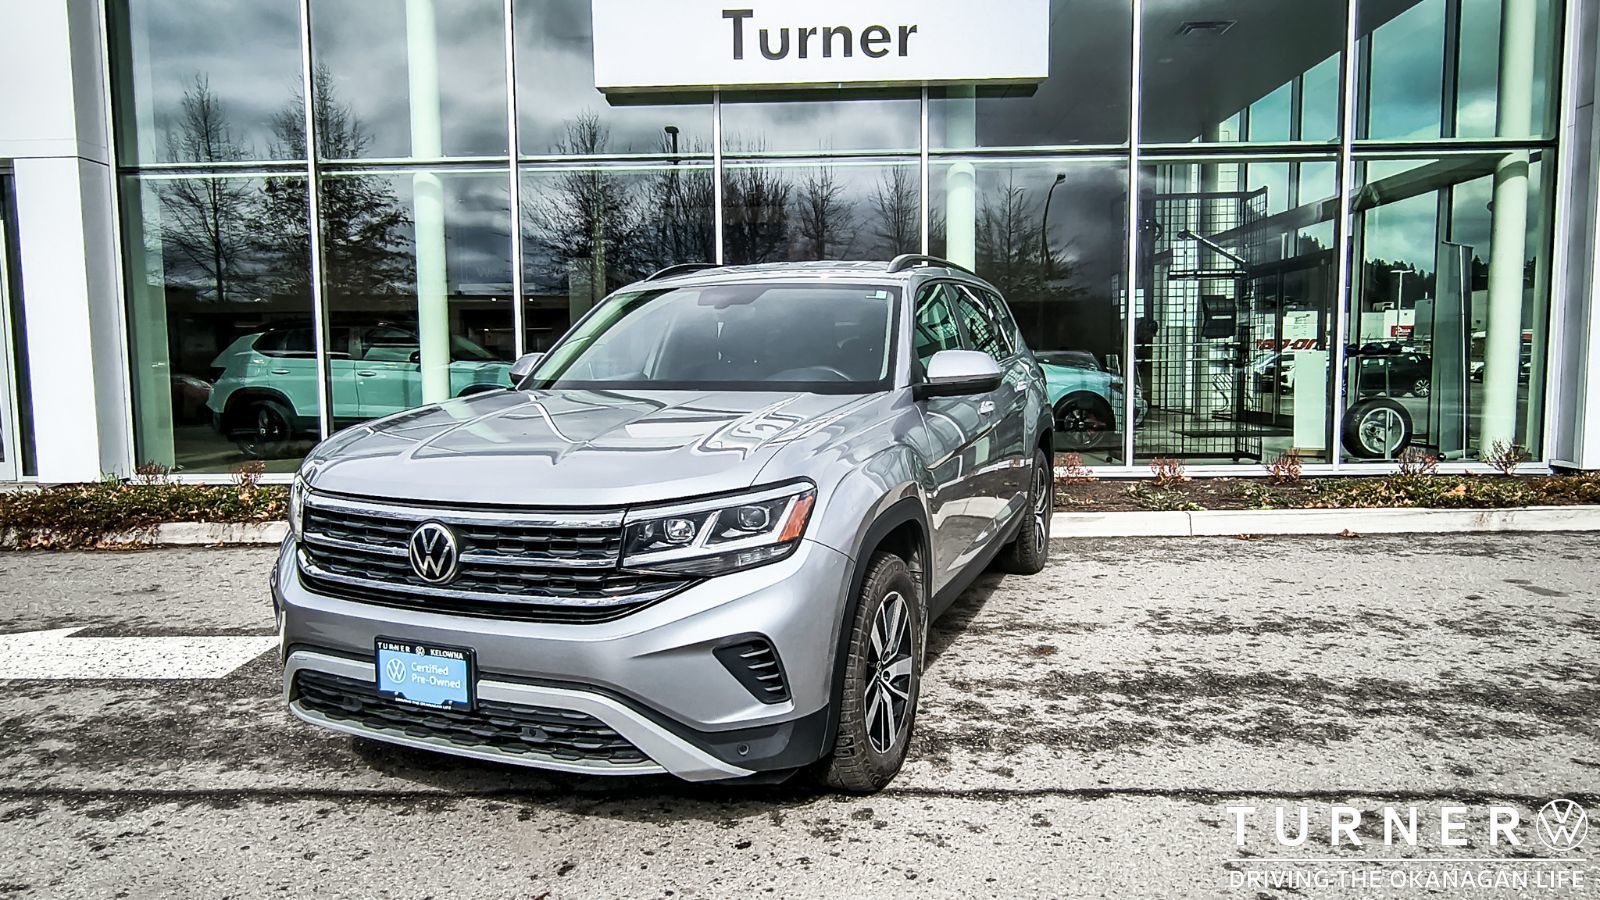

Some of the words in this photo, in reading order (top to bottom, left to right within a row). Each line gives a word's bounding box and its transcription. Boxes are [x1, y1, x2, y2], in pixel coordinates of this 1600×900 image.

[722, 9, 917, 60] Turner
[377, 642, 411, 653] TURNER
[430, 648, 464, 660] KELOWNA
[411, 662, 449, 676] Certified
[411, 673, 461, 689] Pre-Owned
